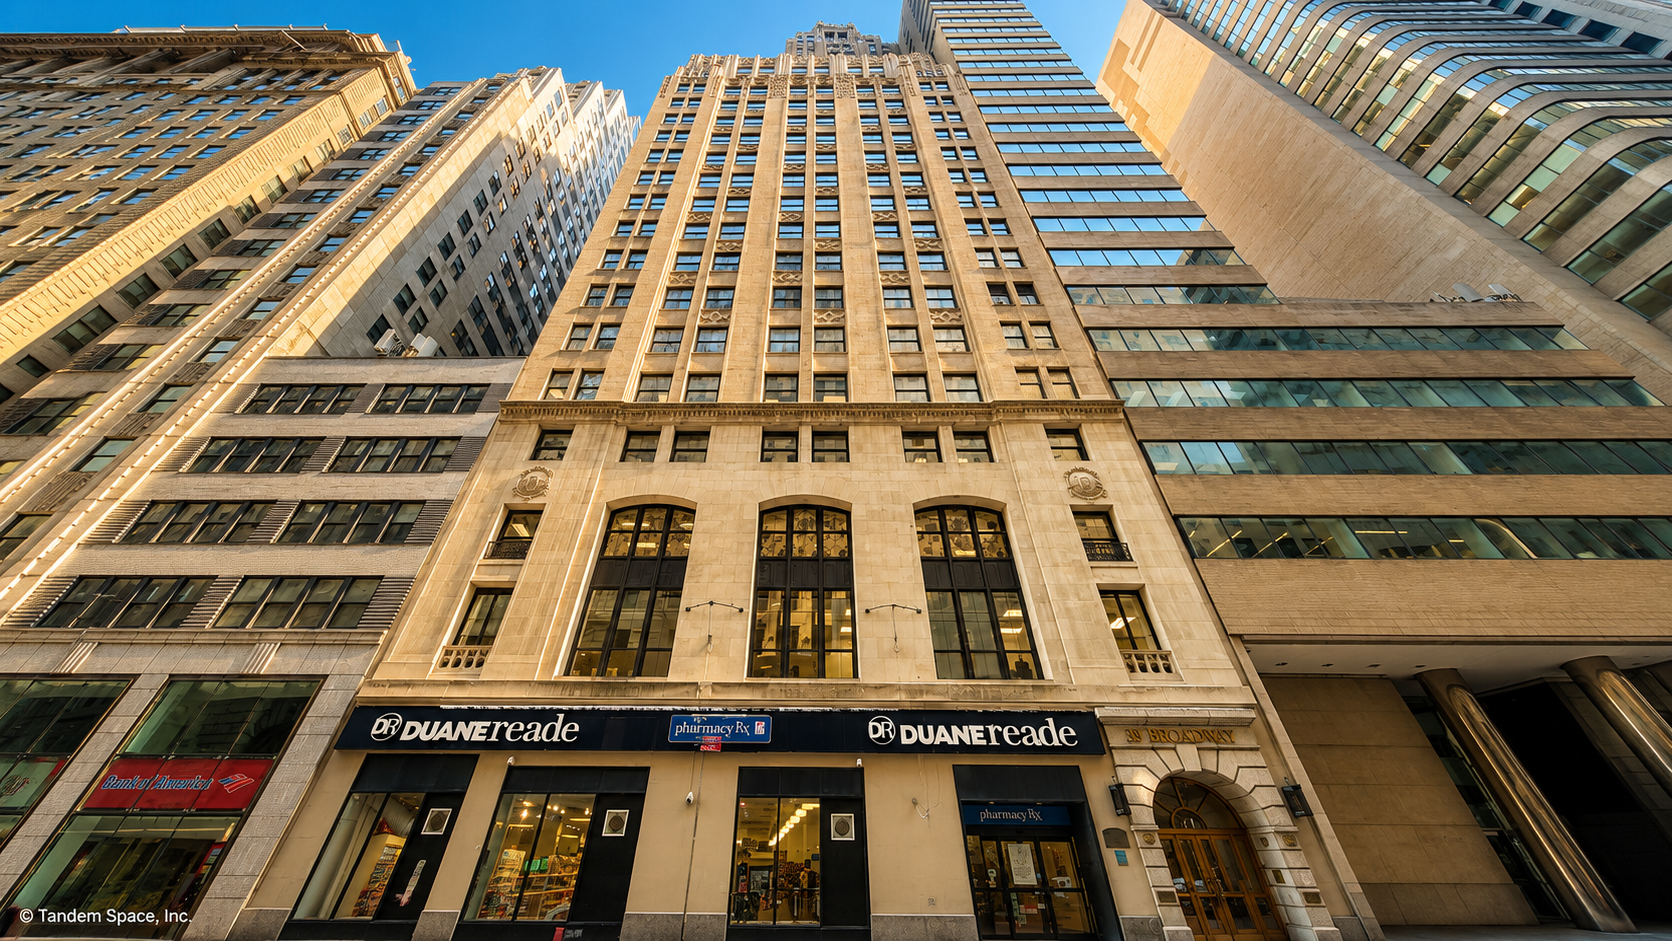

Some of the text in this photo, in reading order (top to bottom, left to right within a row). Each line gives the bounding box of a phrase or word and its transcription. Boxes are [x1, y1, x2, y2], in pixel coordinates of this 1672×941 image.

[371, 716, 402, 738] DR
[675, 721, 750, 739] pharmacy Rx
[868, 719, 895, 741] DR
[1147, 728, 1235, 743] BROADWAY
[101, 774, 140, 790] Bank
[152, 774, 214, 790] America
[980, 808, 1043, 822] pharmacy Rx
